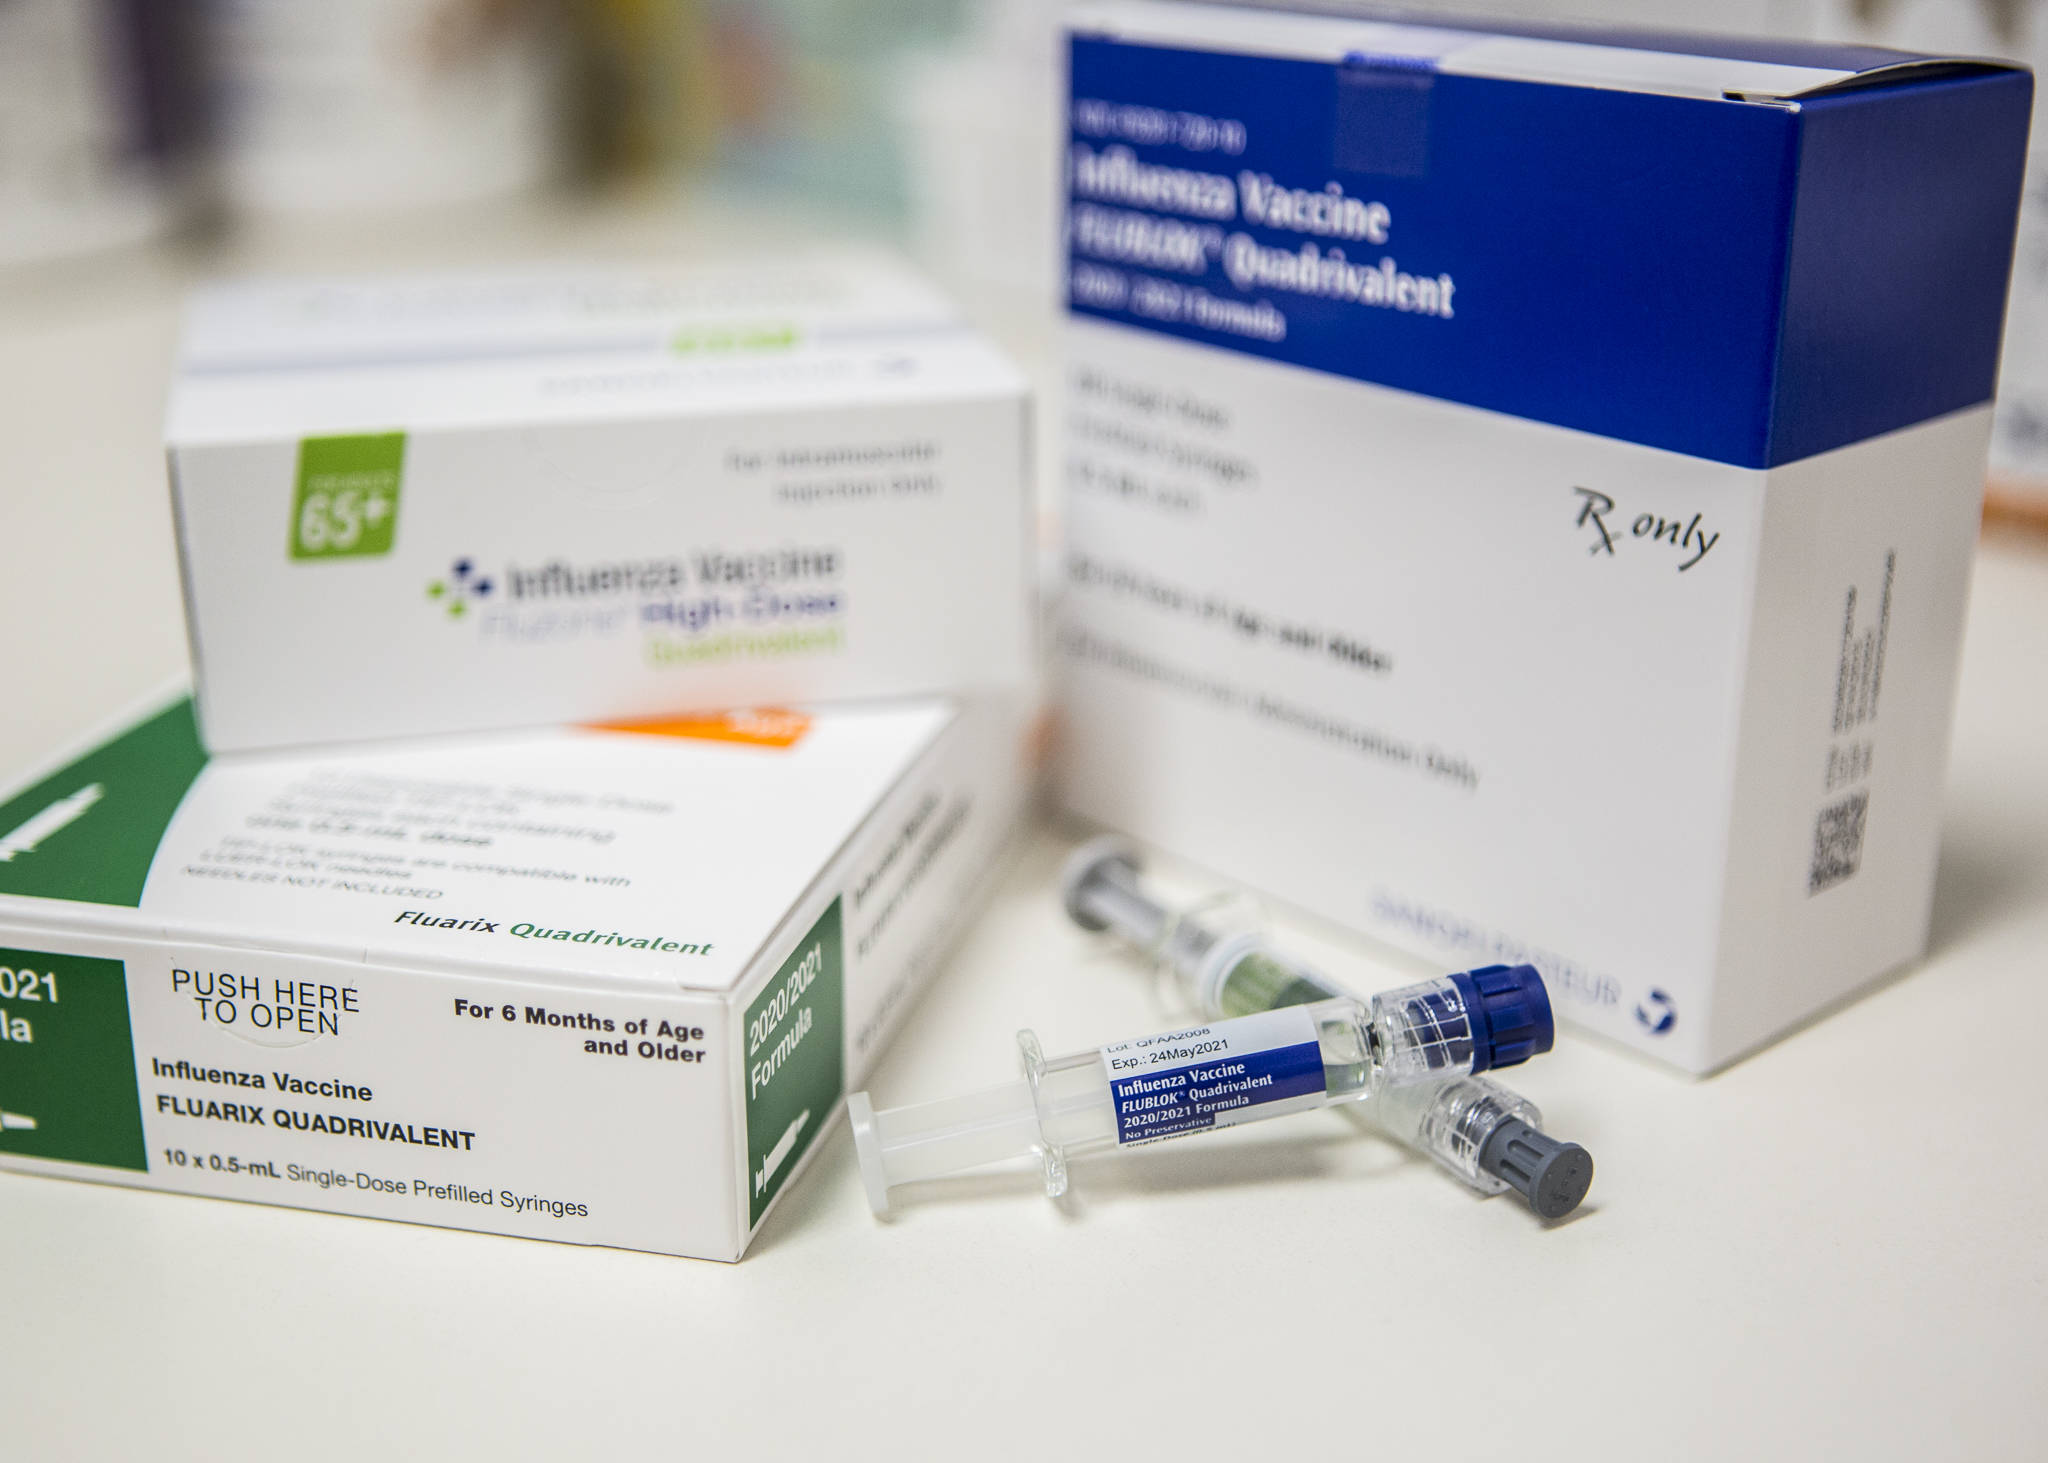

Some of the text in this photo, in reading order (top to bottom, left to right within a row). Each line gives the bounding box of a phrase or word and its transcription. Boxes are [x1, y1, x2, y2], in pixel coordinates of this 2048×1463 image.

[1236, 169, 1391, 245] Vaccine
[1222, 232, 1456, 319] Quadrivalent
[301, 490, 394, 552] 65+
[1632, 511, 1721, 573] only
[506, 550, 840, 598] Influenza Vaccine
[284, 874, 329, 889] NOT
[333, 880, 443, 900] INCLUDED
[585, 875, 631, 888] with
[394, 911, 716, 957] Fluarix Quadrivalent
[172, 968, 360, 1013] PUSH HERE
[749, 942, 822, 1058] 2020/2021
[195, 997, 339, 1036] TO OPEN
[454, 997, 705, 1044] For 6 Months of Age
[584, 1037, 706, 1064] and Older
[752, 1005, 812, 1102] Formula
[1111, 1038, 1229, 1071] Exp.: 24May2021
[152, 1057, 374, 1102] Influenza Vaccine
[1118, 1063, 1246, 1098] Influenza Vaccine
[1189, 1073, 1274, 1101] Quadrivalent
[157, 1093, 476, 1152] FLUARIX QUADRIVALENT
[1123, 1105, 1192, 1129] 2020/2021
[1195, 1094, 1250, 1114] Formula
[1125, 1131, 1142, 1141] No
[1144, 1117, 1213, 1137] Preservative
[163, 1147, 590, 1220] 10 x 0.5-mL Single-Dose Prefilled Syringes
